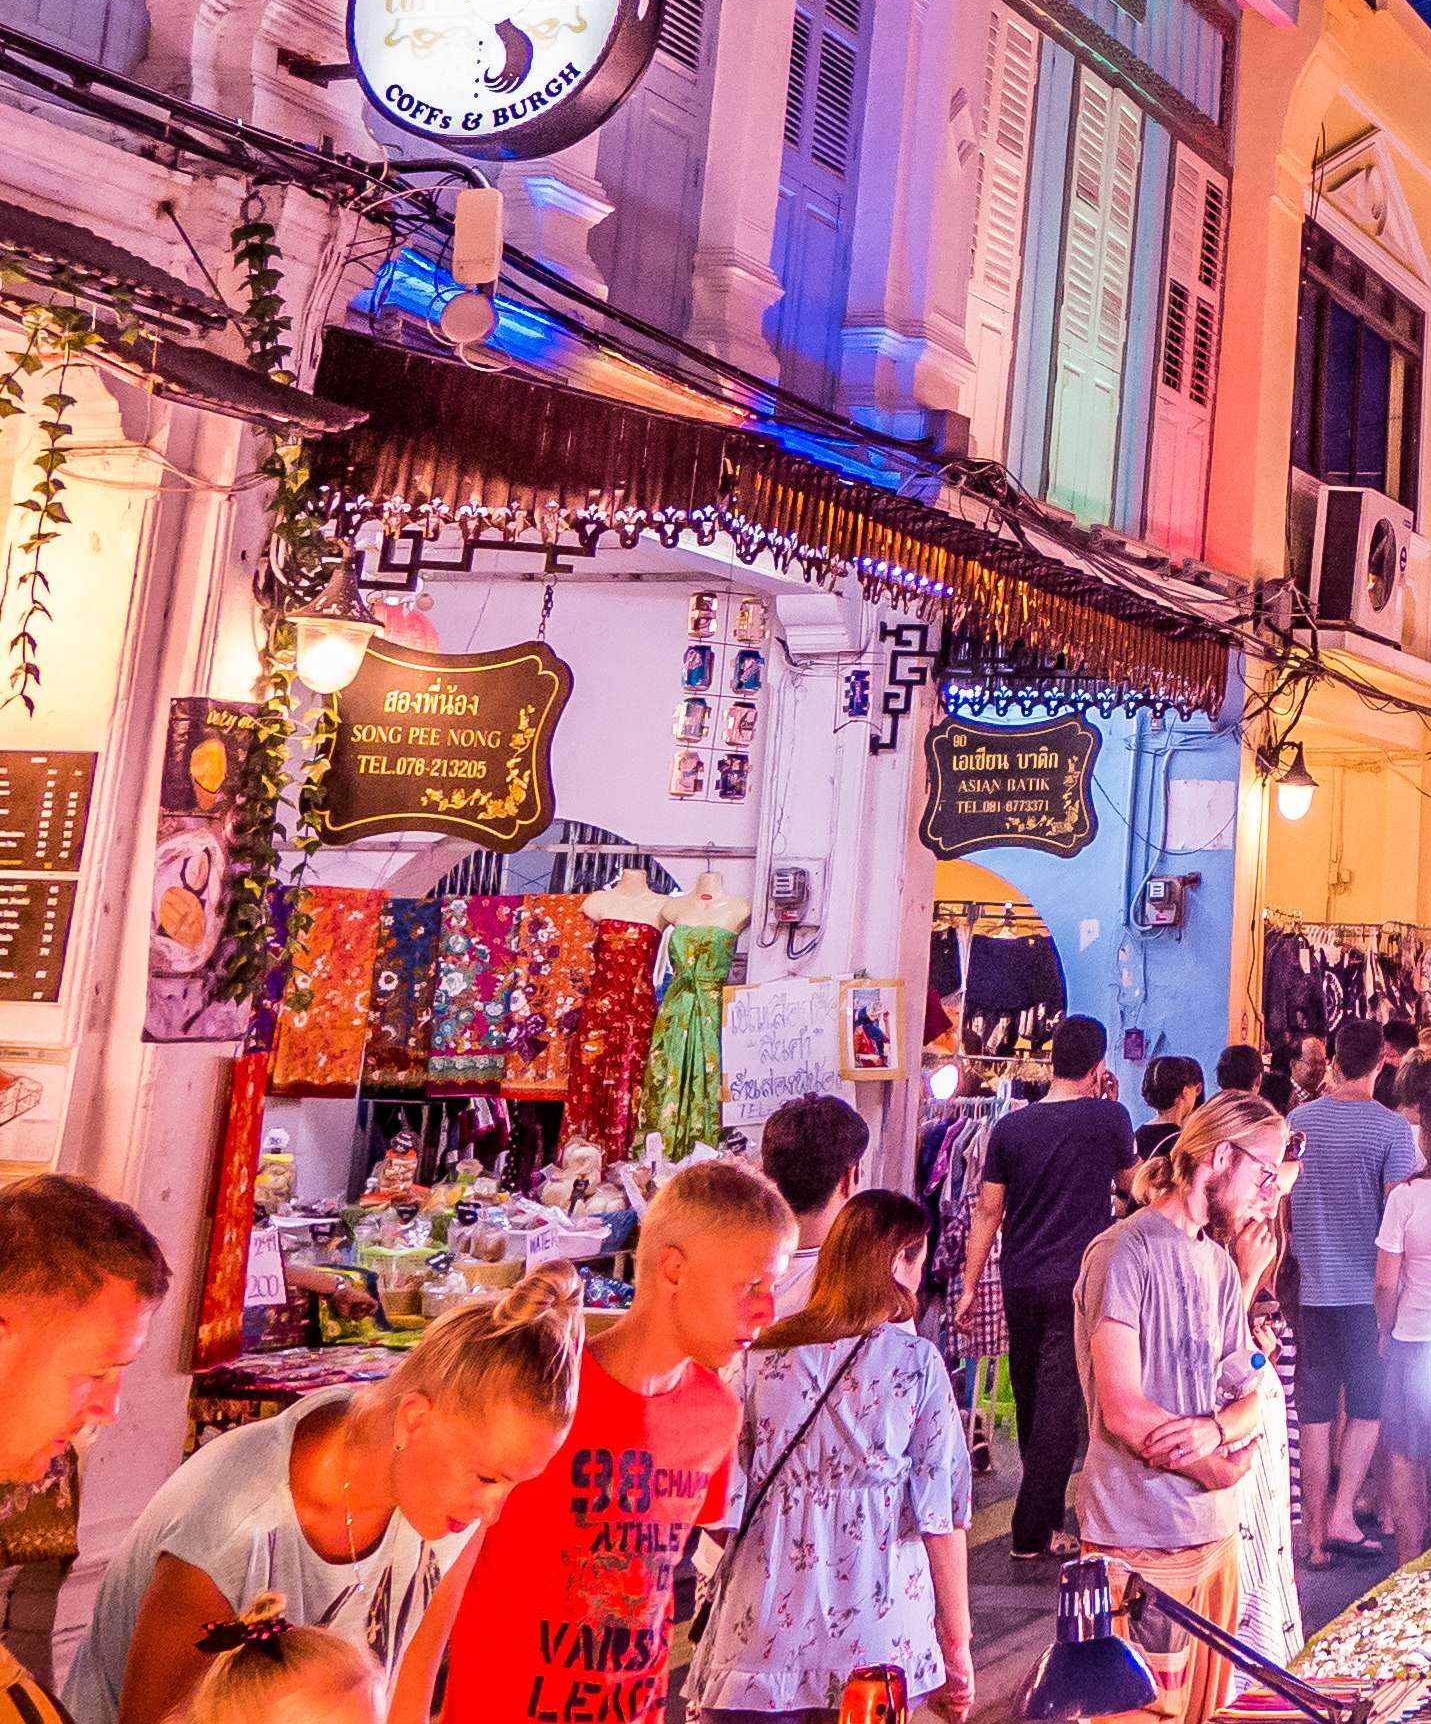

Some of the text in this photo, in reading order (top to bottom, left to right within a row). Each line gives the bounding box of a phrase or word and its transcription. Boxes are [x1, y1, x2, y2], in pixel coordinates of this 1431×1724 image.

[462, 112, 483, 131] &
[493, 62, 582, 128] BURGH
[384, 676, 480, 717] สองพี่น้อง
[351, 724, 502, 749] SONG PEE NONG
[357, 754, 488, 779] TEL.076-213205
[957, 778, 1051, 794] ASIAN BATIK
[569, 1448, 655, 1515] 98
